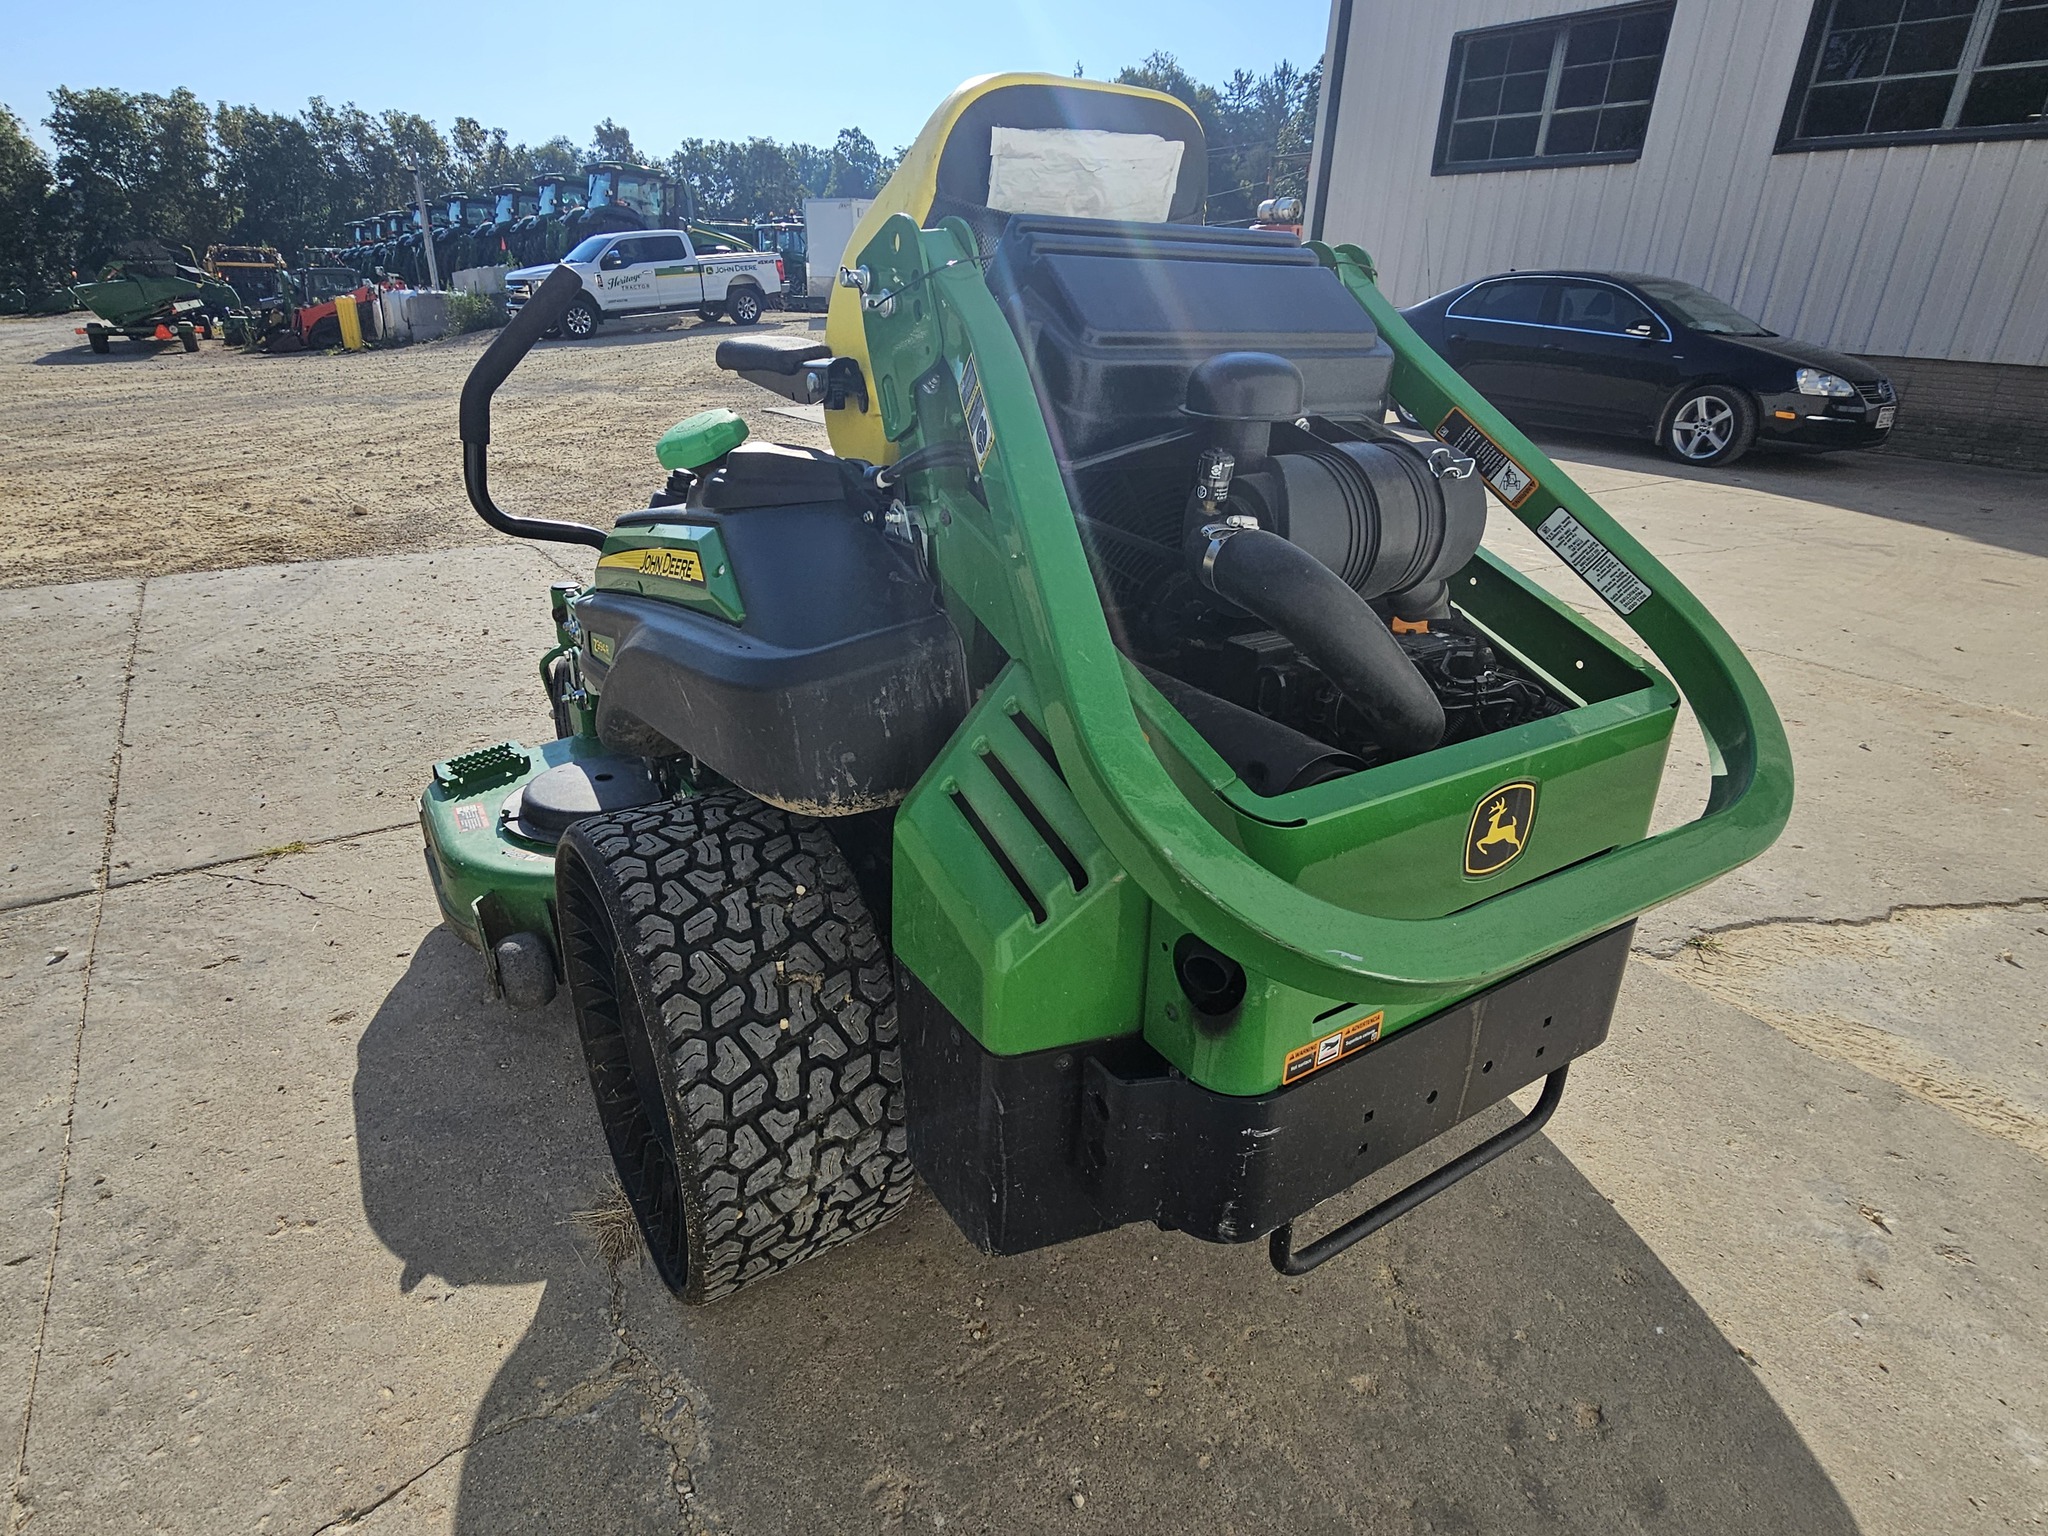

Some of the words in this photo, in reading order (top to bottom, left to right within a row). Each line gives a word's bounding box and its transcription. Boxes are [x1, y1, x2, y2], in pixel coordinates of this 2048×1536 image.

[715, 265, 734, 274] JOHN
[735, 264, 757, 272] DEERE
[608, 273, 642, 290] Heritage
[639, 551, 662, 574] JOHN
[662, 553, 694, 578] DEERE
